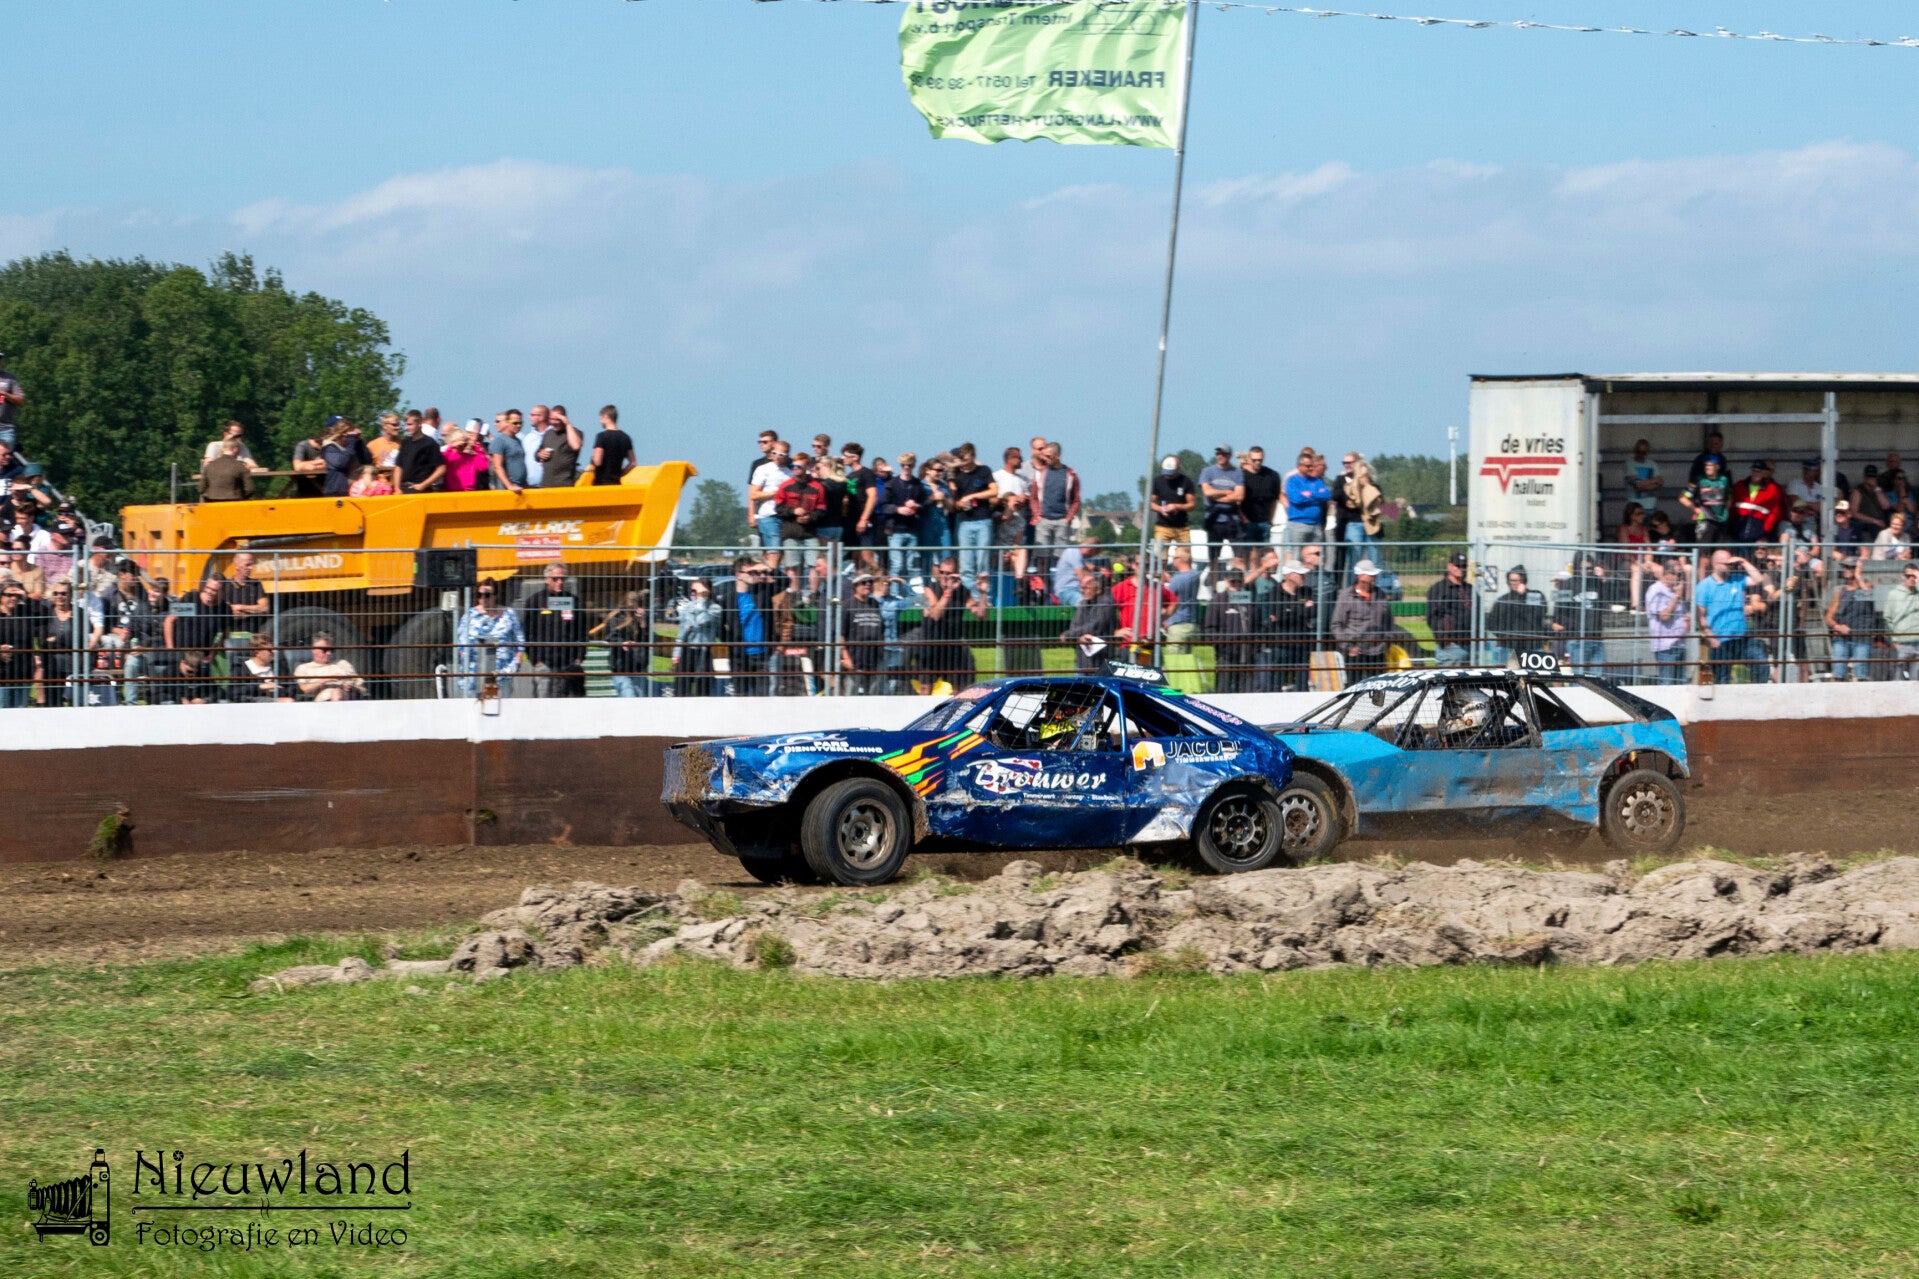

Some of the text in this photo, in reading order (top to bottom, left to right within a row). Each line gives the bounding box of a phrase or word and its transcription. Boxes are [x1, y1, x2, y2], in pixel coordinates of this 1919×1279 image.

[1500, 433, 1565, 454] de vries
[1512, 479, 1554, 496] hallum
[1520, 652, 1557, 670] 100
[966, 759, 1107, 790] Brouwer
